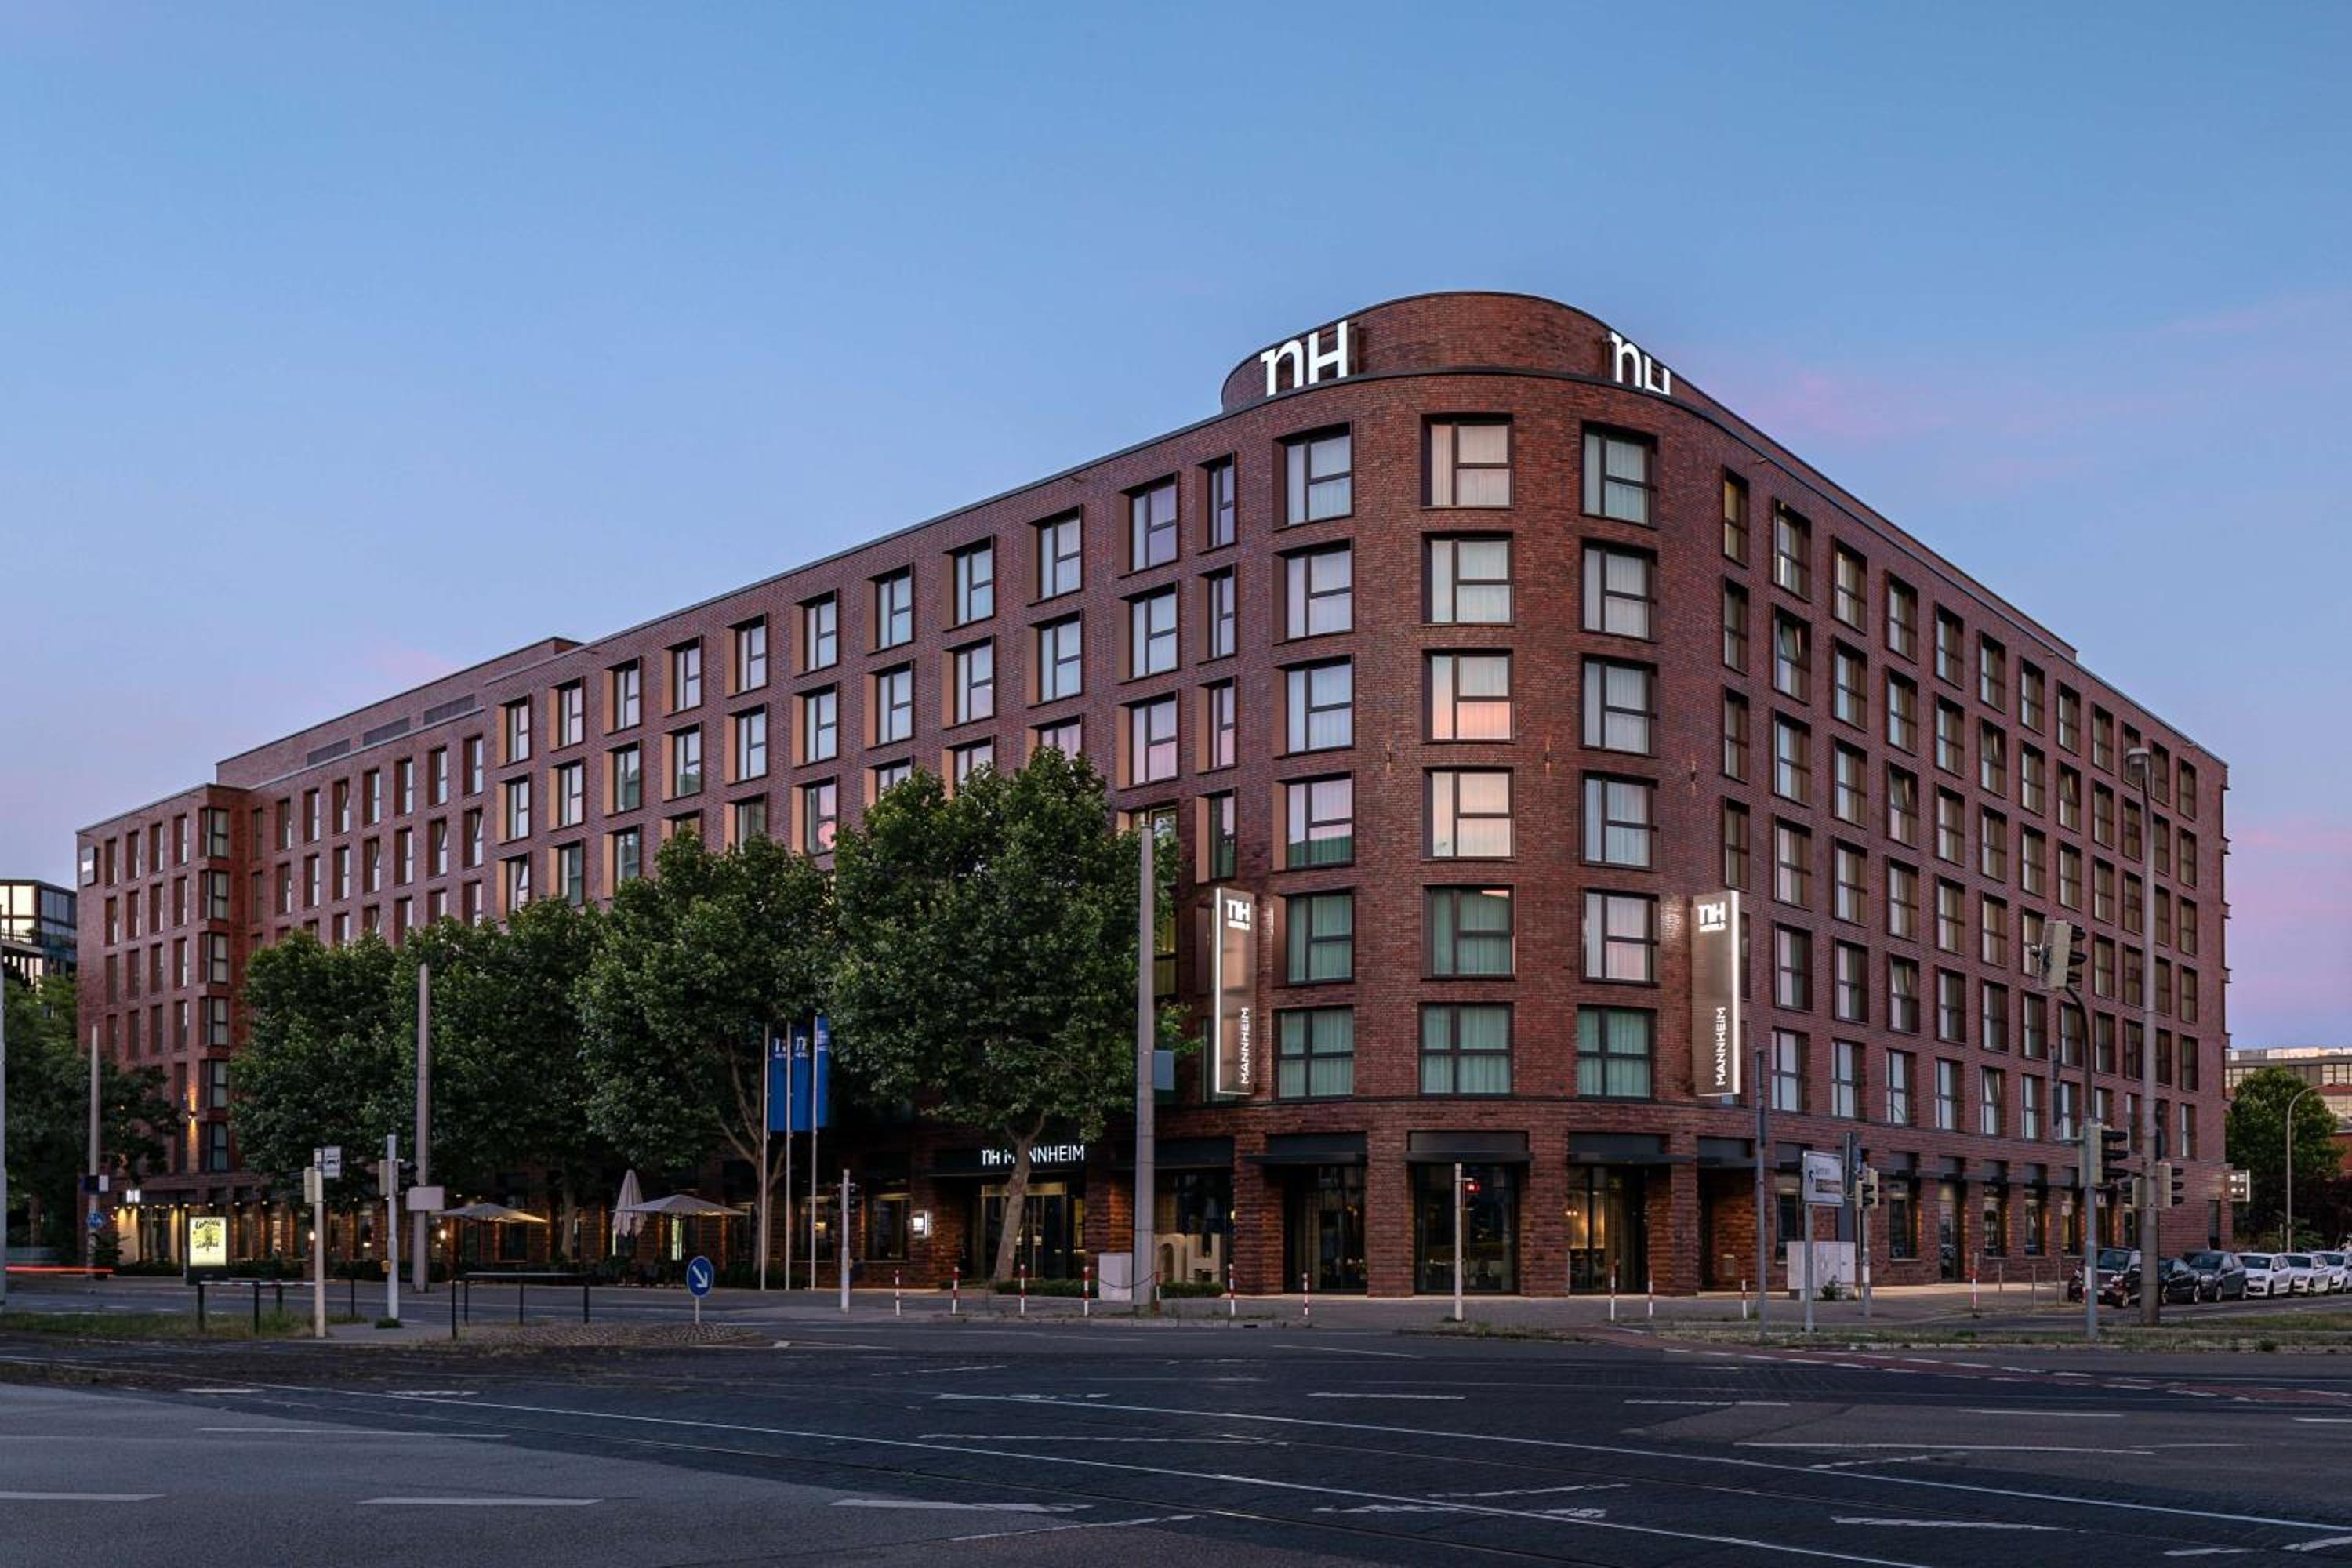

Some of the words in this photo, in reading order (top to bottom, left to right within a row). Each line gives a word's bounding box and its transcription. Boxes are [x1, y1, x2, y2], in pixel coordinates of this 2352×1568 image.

[1260, 320, 1348, 397] nH
[1241, 1007, 1250, 1084] MANNHEIM
[1715, 1007, 1726, 1086] MANNHEIM
[1004, 1144, 1084, 1165] MNNHEIM
